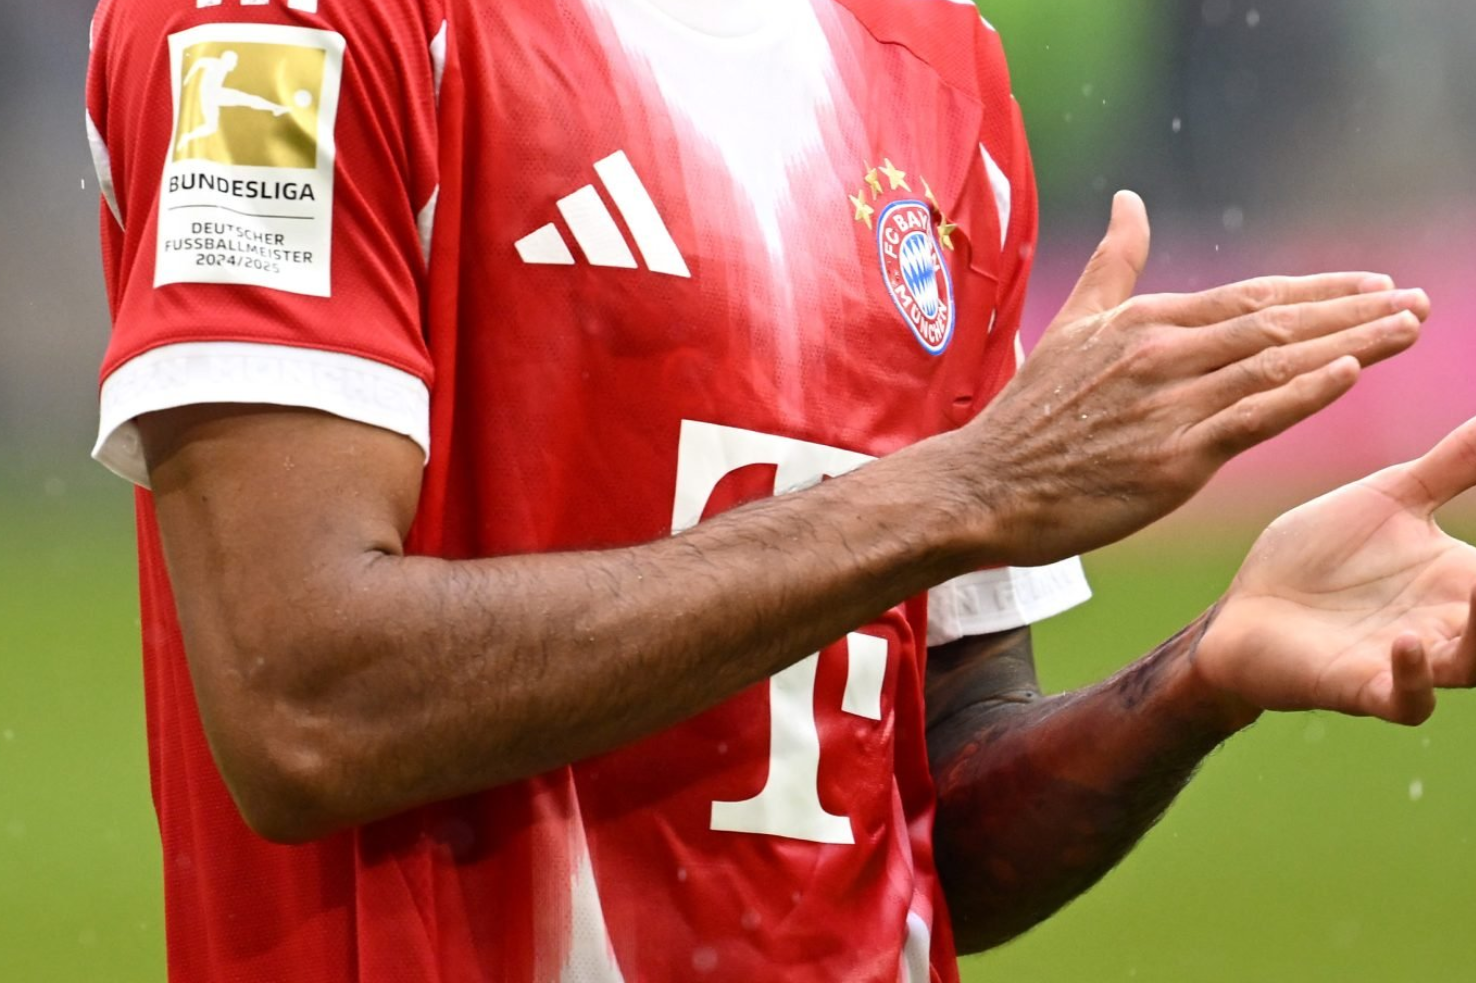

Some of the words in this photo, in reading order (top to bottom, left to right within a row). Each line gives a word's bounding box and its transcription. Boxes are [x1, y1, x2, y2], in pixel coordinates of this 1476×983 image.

[169, 173, 315, 201] BUNDESLIGA
[192, 222, 285, 246] DEUTSCHER
[884, 227, 900, 259] FC
[165, 237, 313, 264] FUSSBALLMEISTER
[196, 253, 280, 274] 2024/2025
